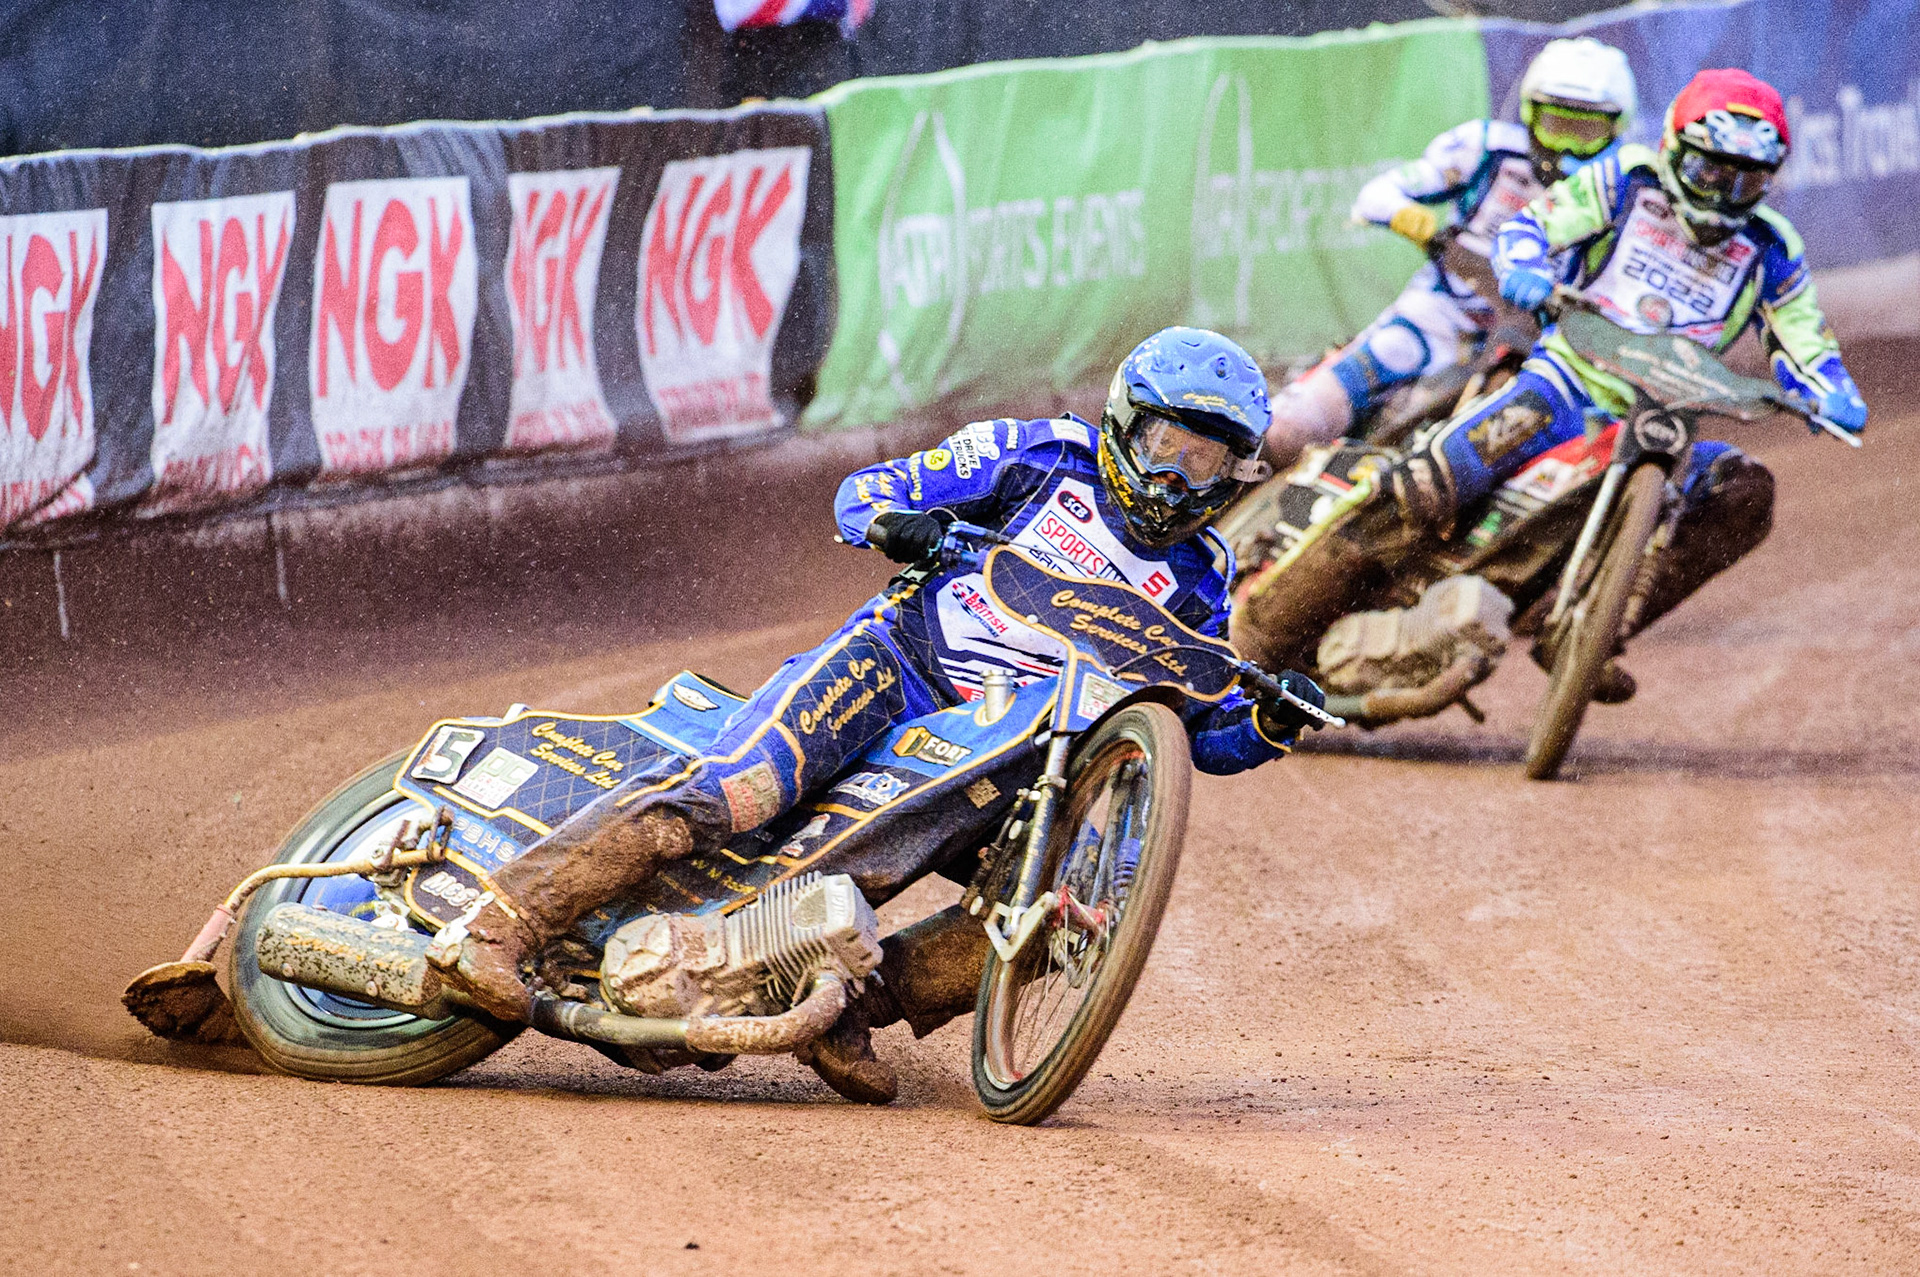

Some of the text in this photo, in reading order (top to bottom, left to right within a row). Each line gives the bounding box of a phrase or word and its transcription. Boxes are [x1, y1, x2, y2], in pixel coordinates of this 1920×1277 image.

[511, 183, 609, 380] NGK
[644, 164, 793, 357] NGK
[317, 197, 463, 398] NGK
[1624, 260, 1714, 316] 2022
[162, 205, 291, 426] NGK
[953, 440, 970, 476] TRUCKS
[963, 438, 978, 466] DRIVE
[1062, 497, 1088, 519] SCB
[1041, 517, 1104, 575] SPORTS
[1142, 571, 1171, 598] 5
[965, 592, 1009, 634] BRITISH
[1051, 589, 1141, 631] Complete
[1070, 613, 1188, 678] Services Ltd
[421, 730, 476, 777] 5
[530, 742, 622, 790] Services Ltd
[531, 721, 625, 773] Complete Car
[923, 735, 974, 760] FORT
